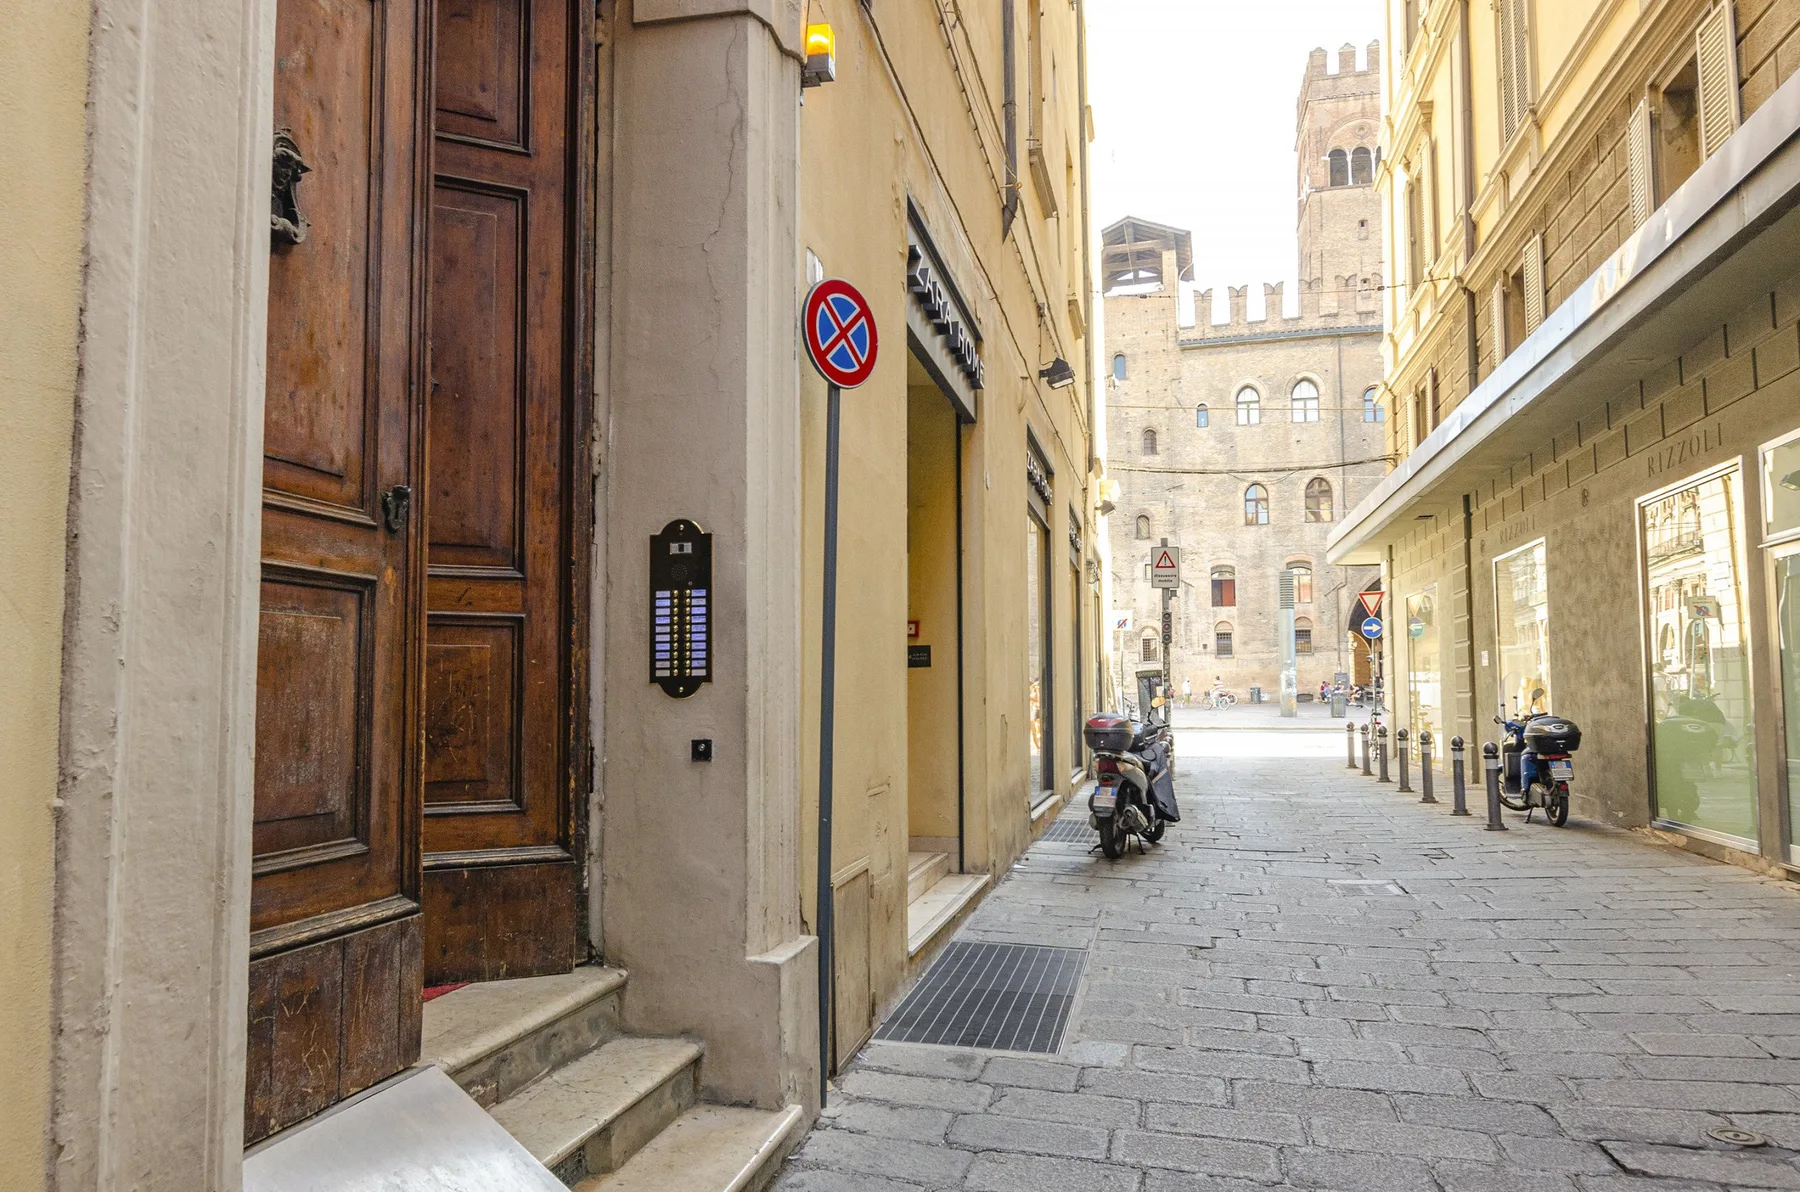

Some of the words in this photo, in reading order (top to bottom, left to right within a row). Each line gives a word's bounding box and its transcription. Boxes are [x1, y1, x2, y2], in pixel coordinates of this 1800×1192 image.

[909, 245, 952, 335] ZARA
[956, 321, 984, 389] HOME
[1647, 423, 1722, 477] RIZZOLI
[1499, 514, 1536, 545] RIZZOLI
